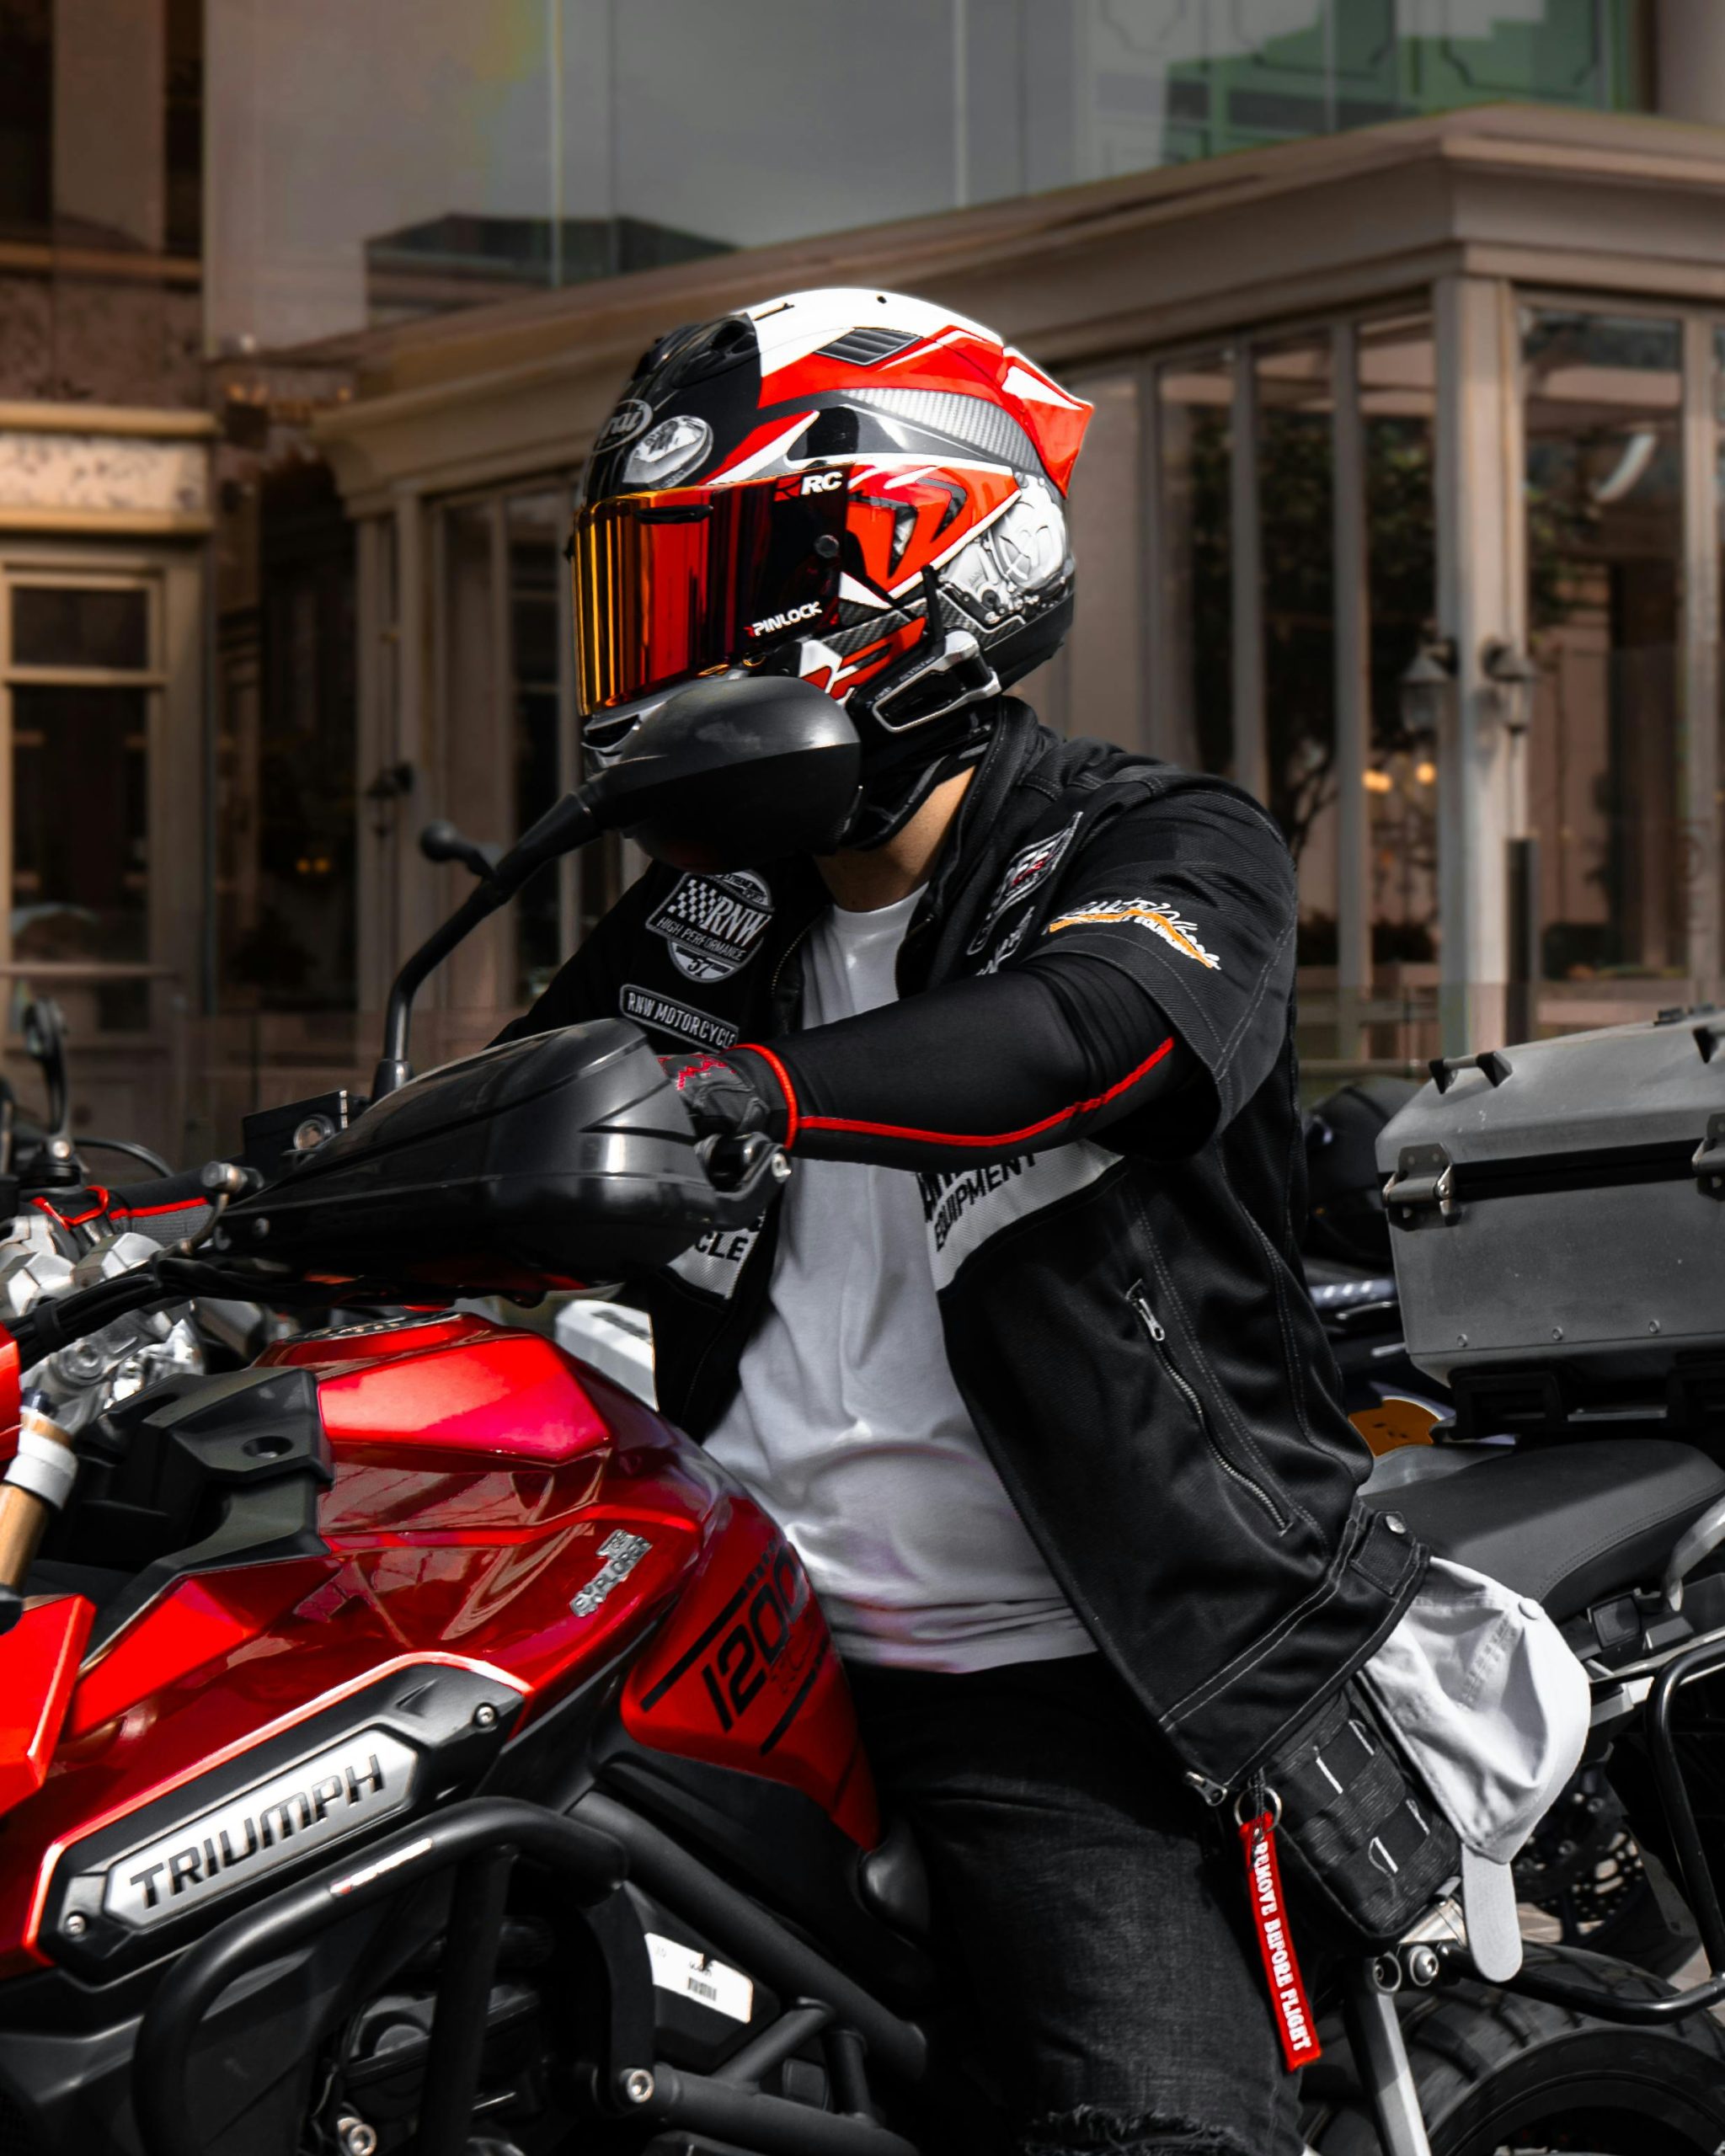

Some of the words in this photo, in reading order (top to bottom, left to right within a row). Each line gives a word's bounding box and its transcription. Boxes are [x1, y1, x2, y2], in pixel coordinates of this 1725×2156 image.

[801, 472, 843, 495] RC
[752, 601, 823, 637] PINLOCK
[656, 916, 681, 937] HIGH
[681, 928, 746, 961] PERFORMANCE
[699, 894, 772, 947] RNW
[628, 992, 655, 1018] RNW
[701, 1543, 811, 1733] 1200
[129, 1753, 387, 1910] TRIUMPH
[1263, 1918, 1295, 1988] BEFORE
[1279, 1988, 1312, 2052] FLIGHT
